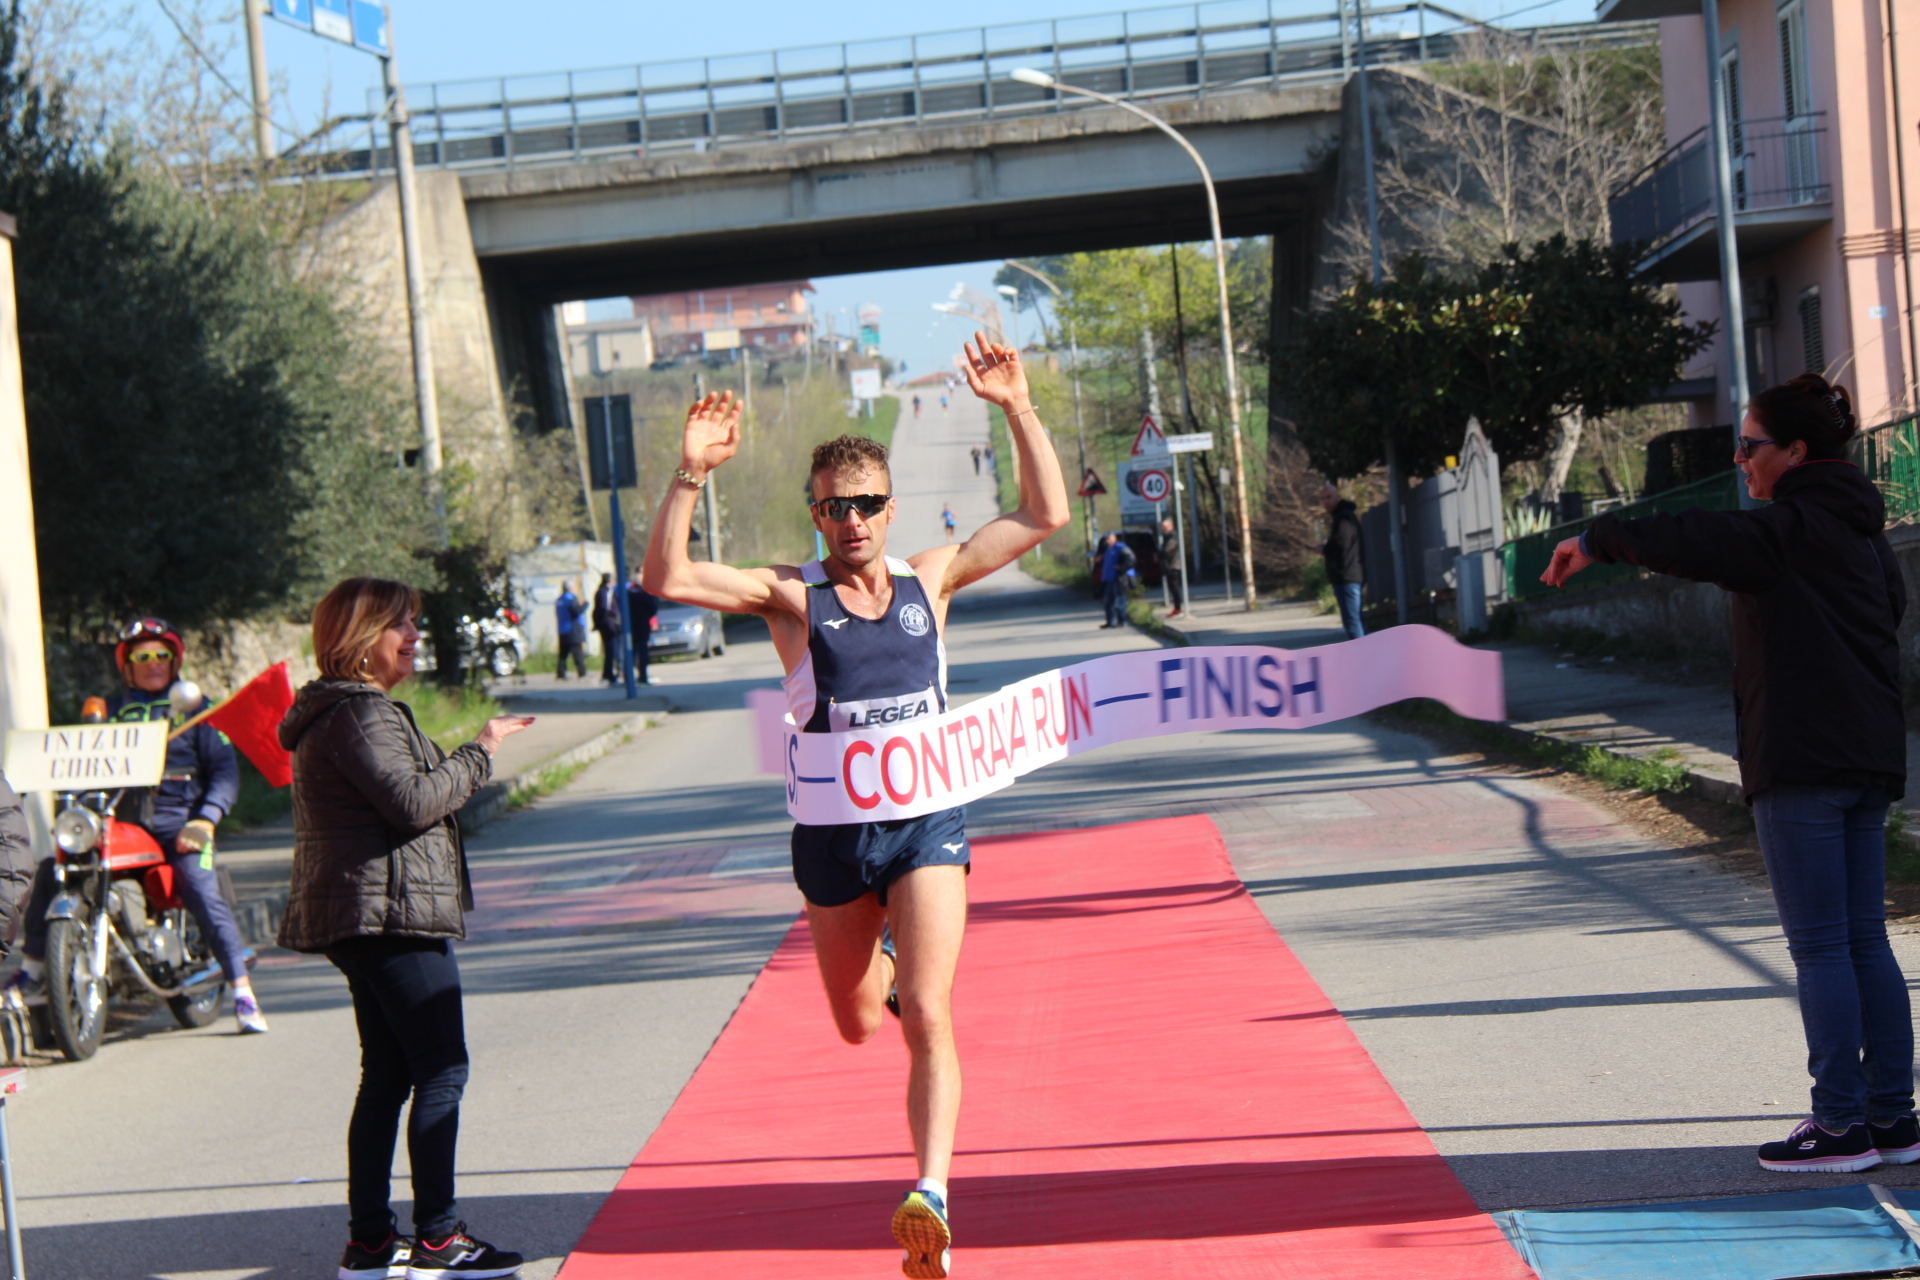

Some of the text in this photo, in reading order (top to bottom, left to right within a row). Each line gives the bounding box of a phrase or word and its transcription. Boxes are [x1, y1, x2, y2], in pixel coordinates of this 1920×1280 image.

[1146, 478, 1163, 492] 40
[849, 699, 929, 727] LEGEA
[1032, 673, 1094, 752] RUN
[1157, 655, 1324, 723] FINISH
[43, 728, 140, 753] INIZIO
[50, 756, 131, 778] CORSA
